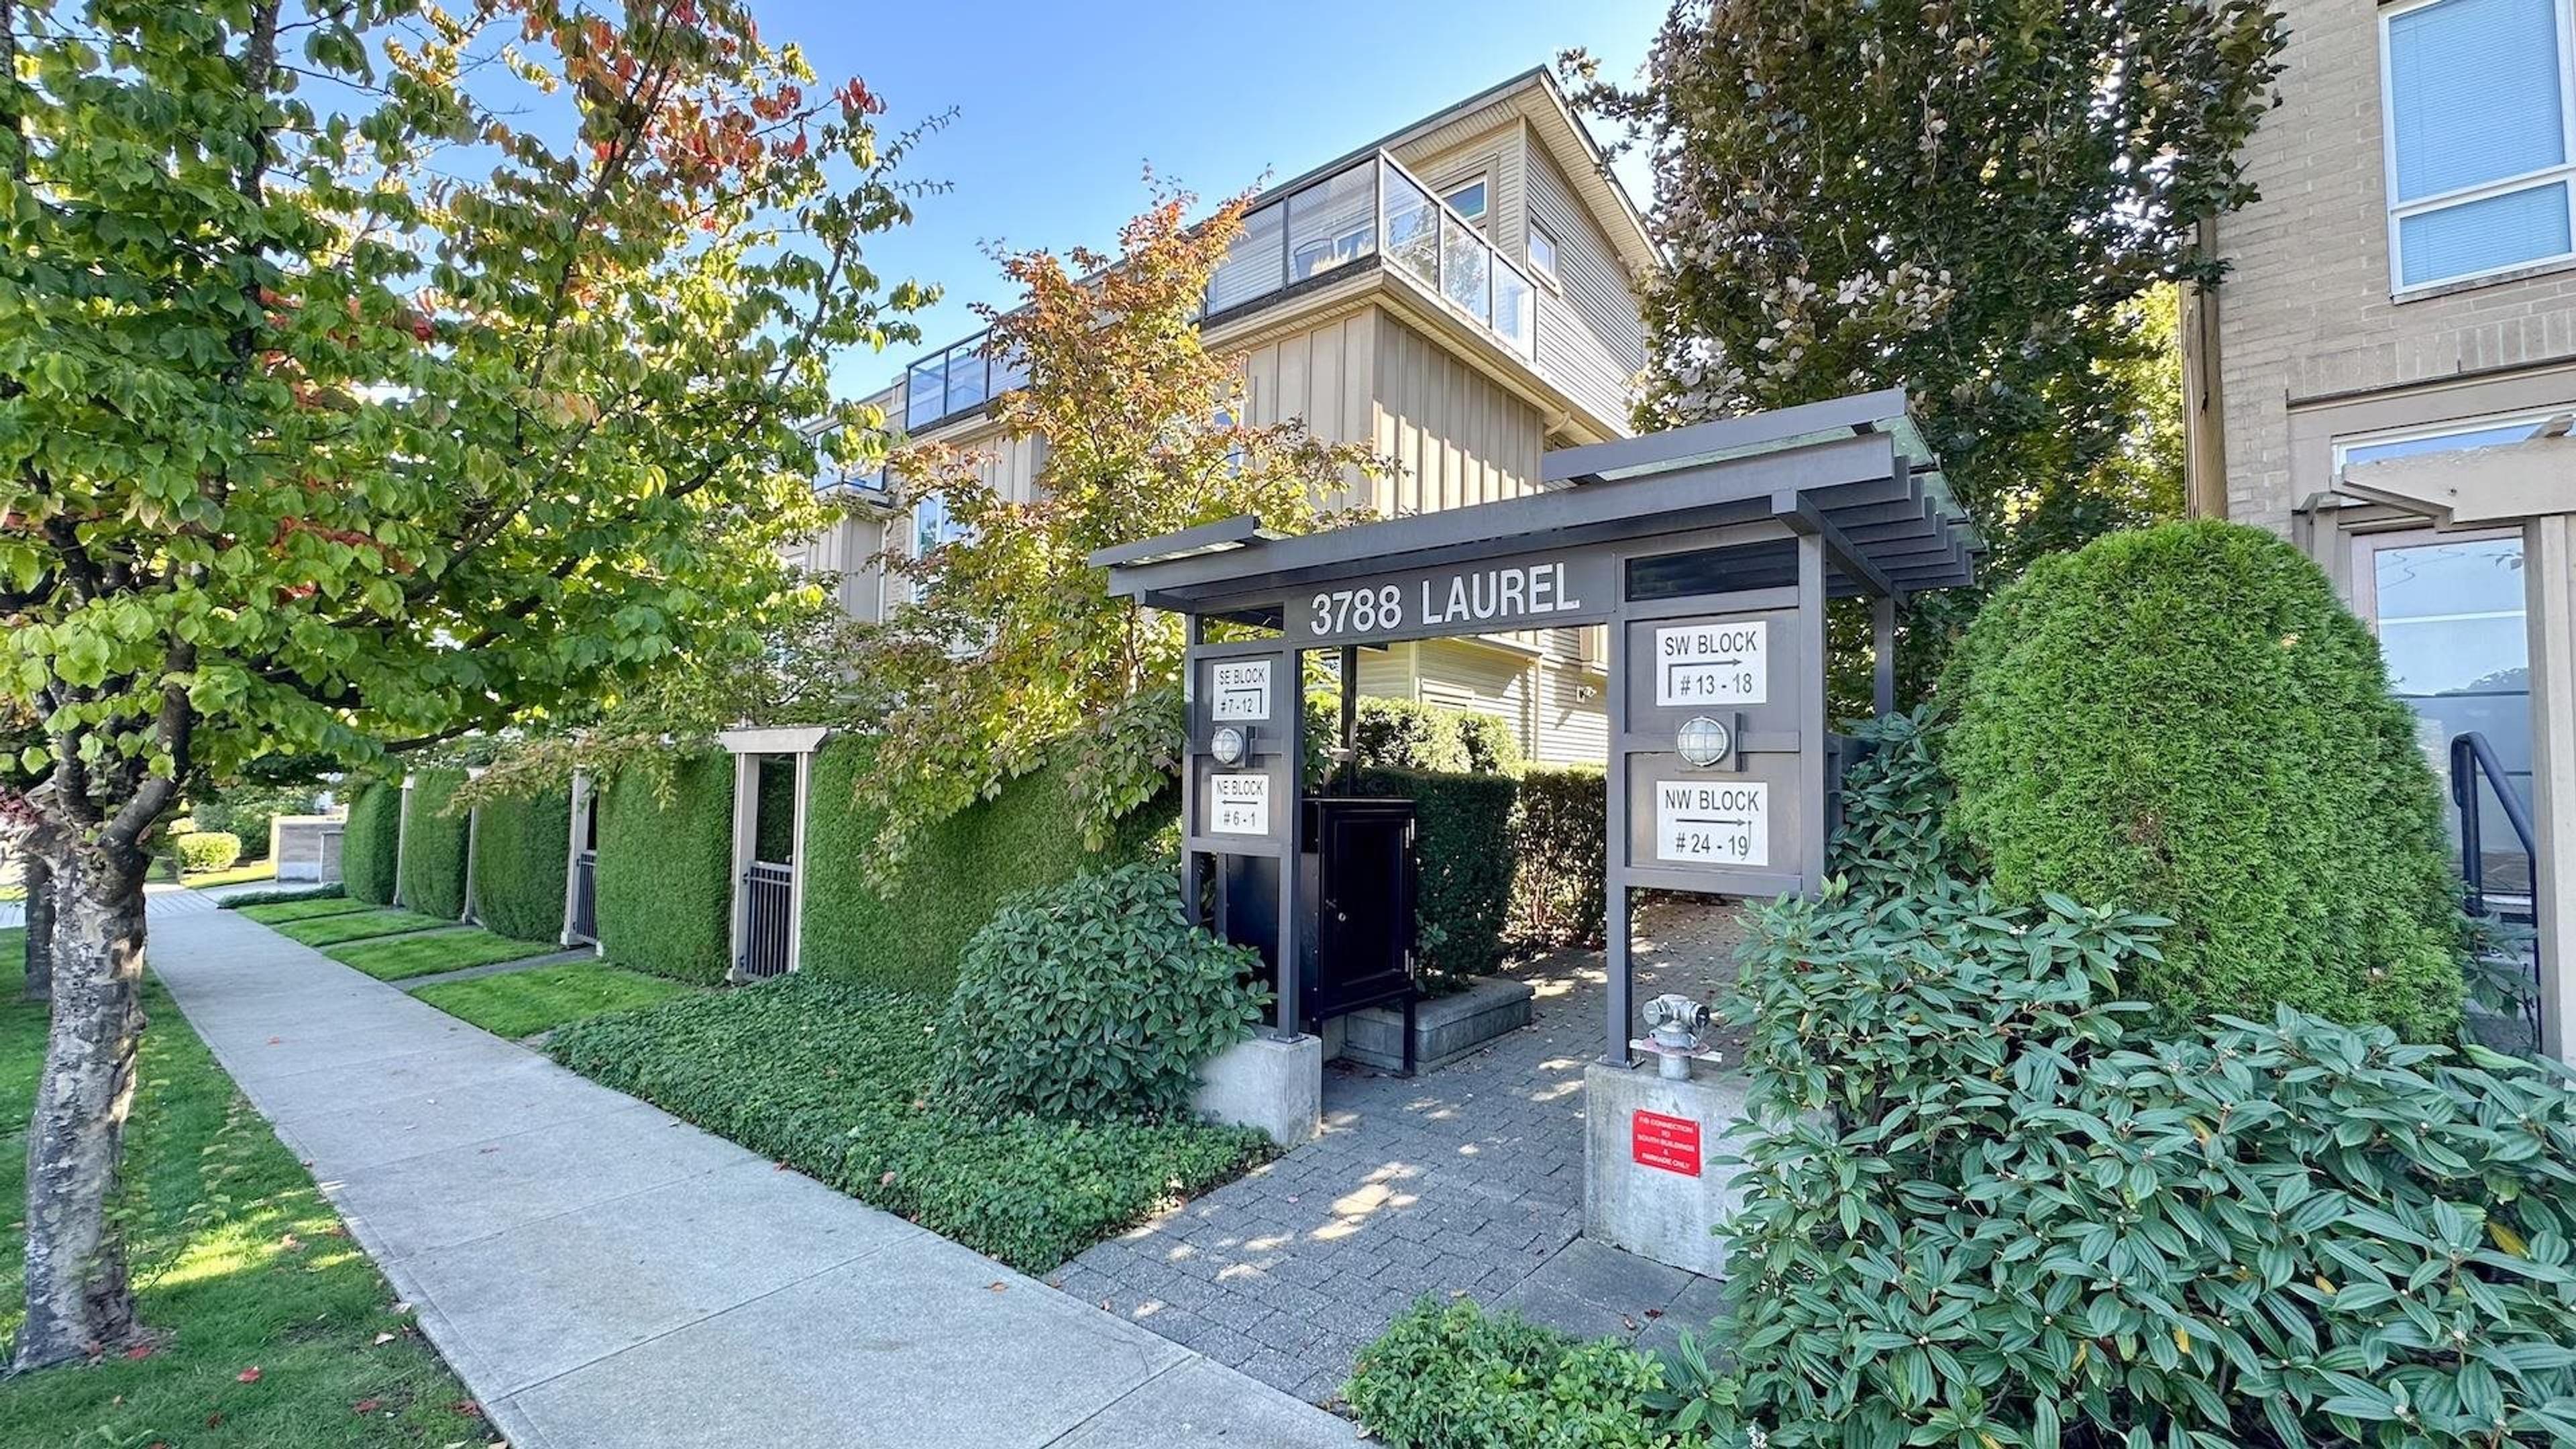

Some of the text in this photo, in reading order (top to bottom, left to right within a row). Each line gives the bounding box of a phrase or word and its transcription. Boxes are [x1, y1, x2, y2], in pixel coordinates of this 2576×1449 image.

[1309, 561, 1580, 637] 3788 LAUREL
[1665, 631, 1757, 655] SW BLOCK
[1220, 667, 1265, 685] SE BLOCK
[1217, 780, 1263, 796] NE BLOCK
[1665, 790, 1759, 811] NW BLOCK
[1661, 1130, 1672, 1139] TO
